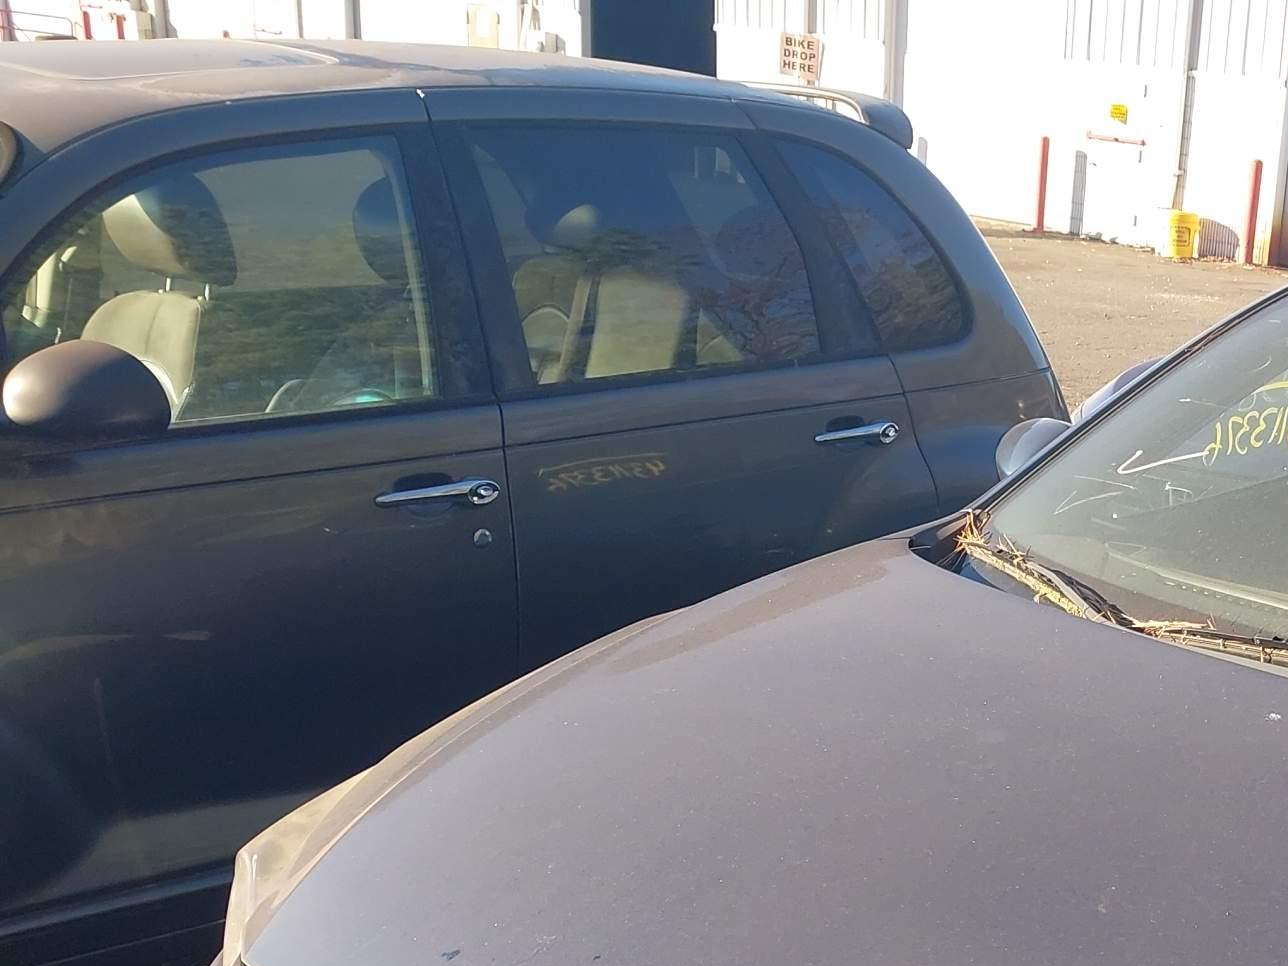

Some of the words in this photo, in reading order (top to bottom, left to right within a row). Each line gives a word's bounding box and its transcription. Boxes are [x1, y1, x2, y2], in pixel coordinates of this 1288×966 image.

[785, 36, 815, 51] BIKE
[783, 48, 816, 62] DROP
[783, 60, 815, 73] HERE
